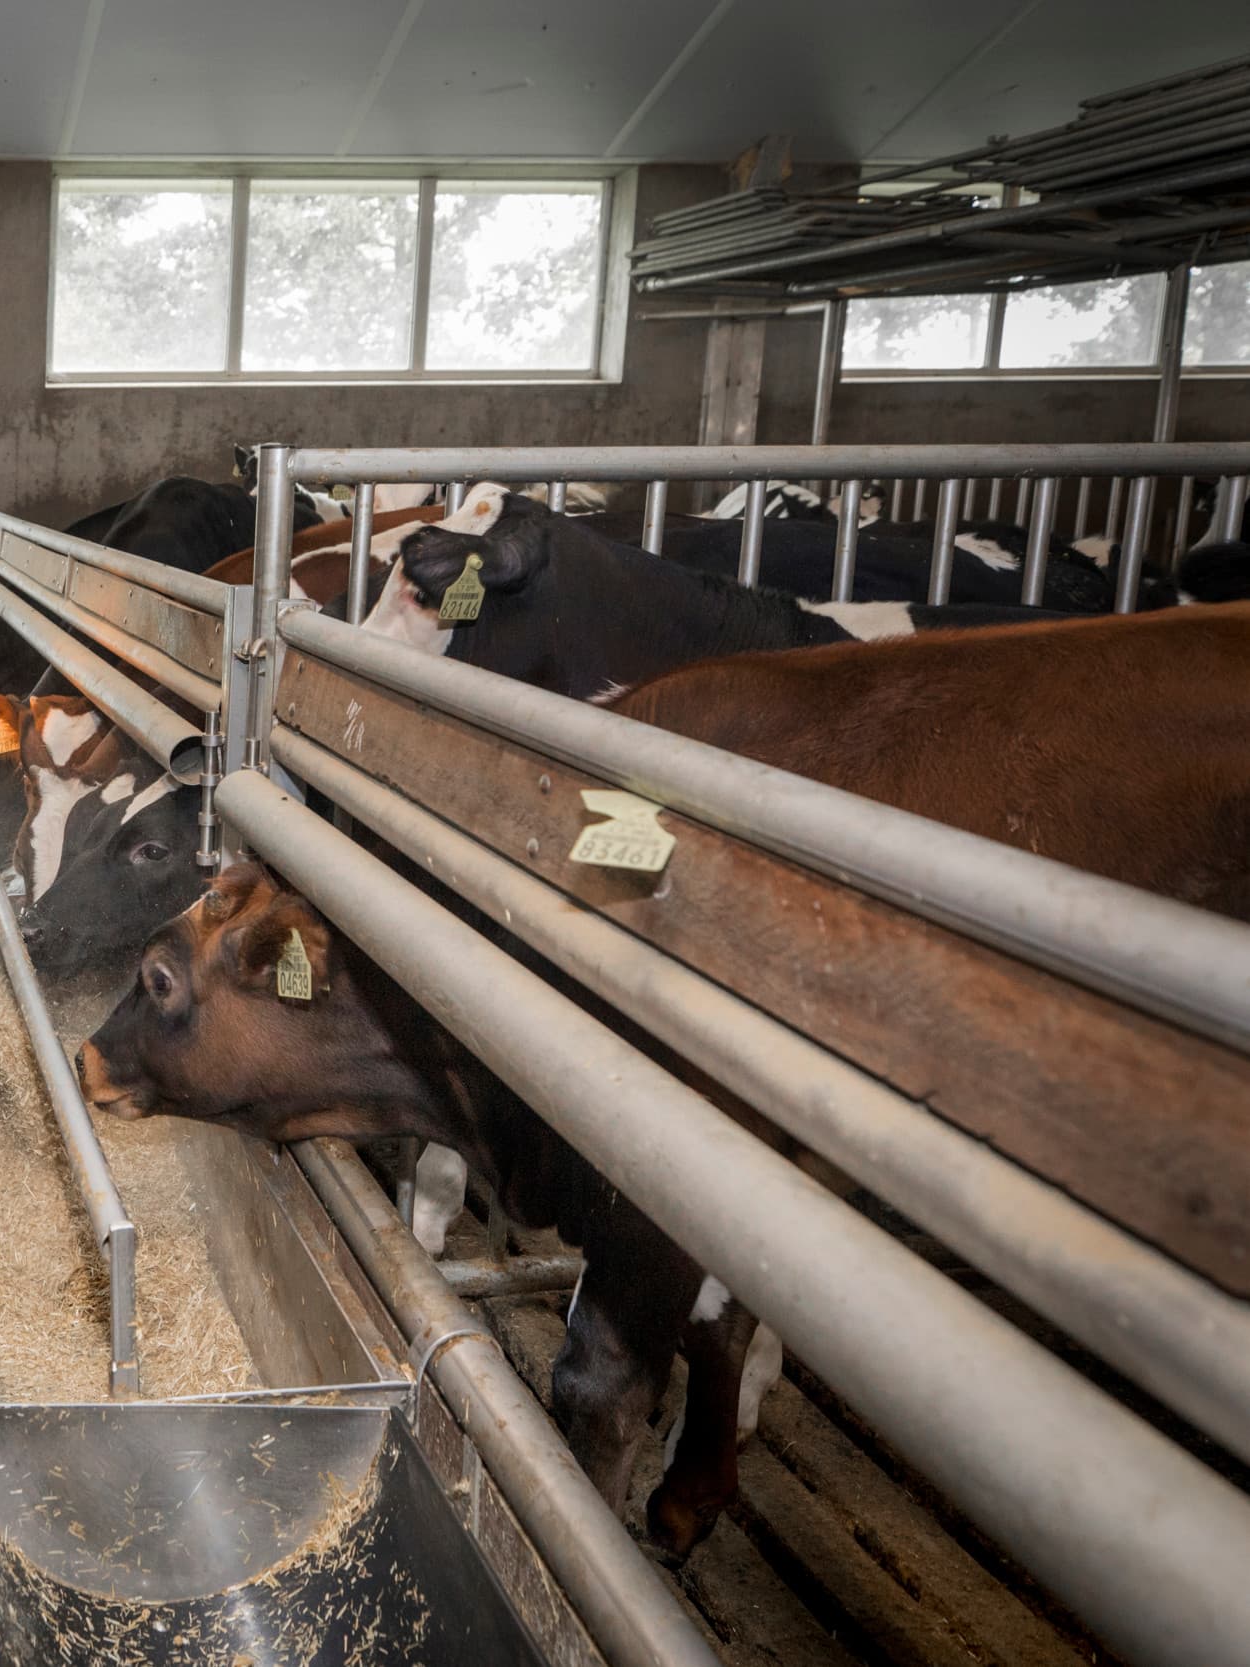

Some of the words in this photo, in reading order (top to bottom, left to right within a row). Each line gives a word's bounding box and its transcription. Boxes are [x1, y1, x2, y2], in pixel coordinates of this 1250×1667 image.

[440, 601, 479, 618] 62146
[577, 840, 660, 867] 83461
[280, 971, 309, 997] 04639
